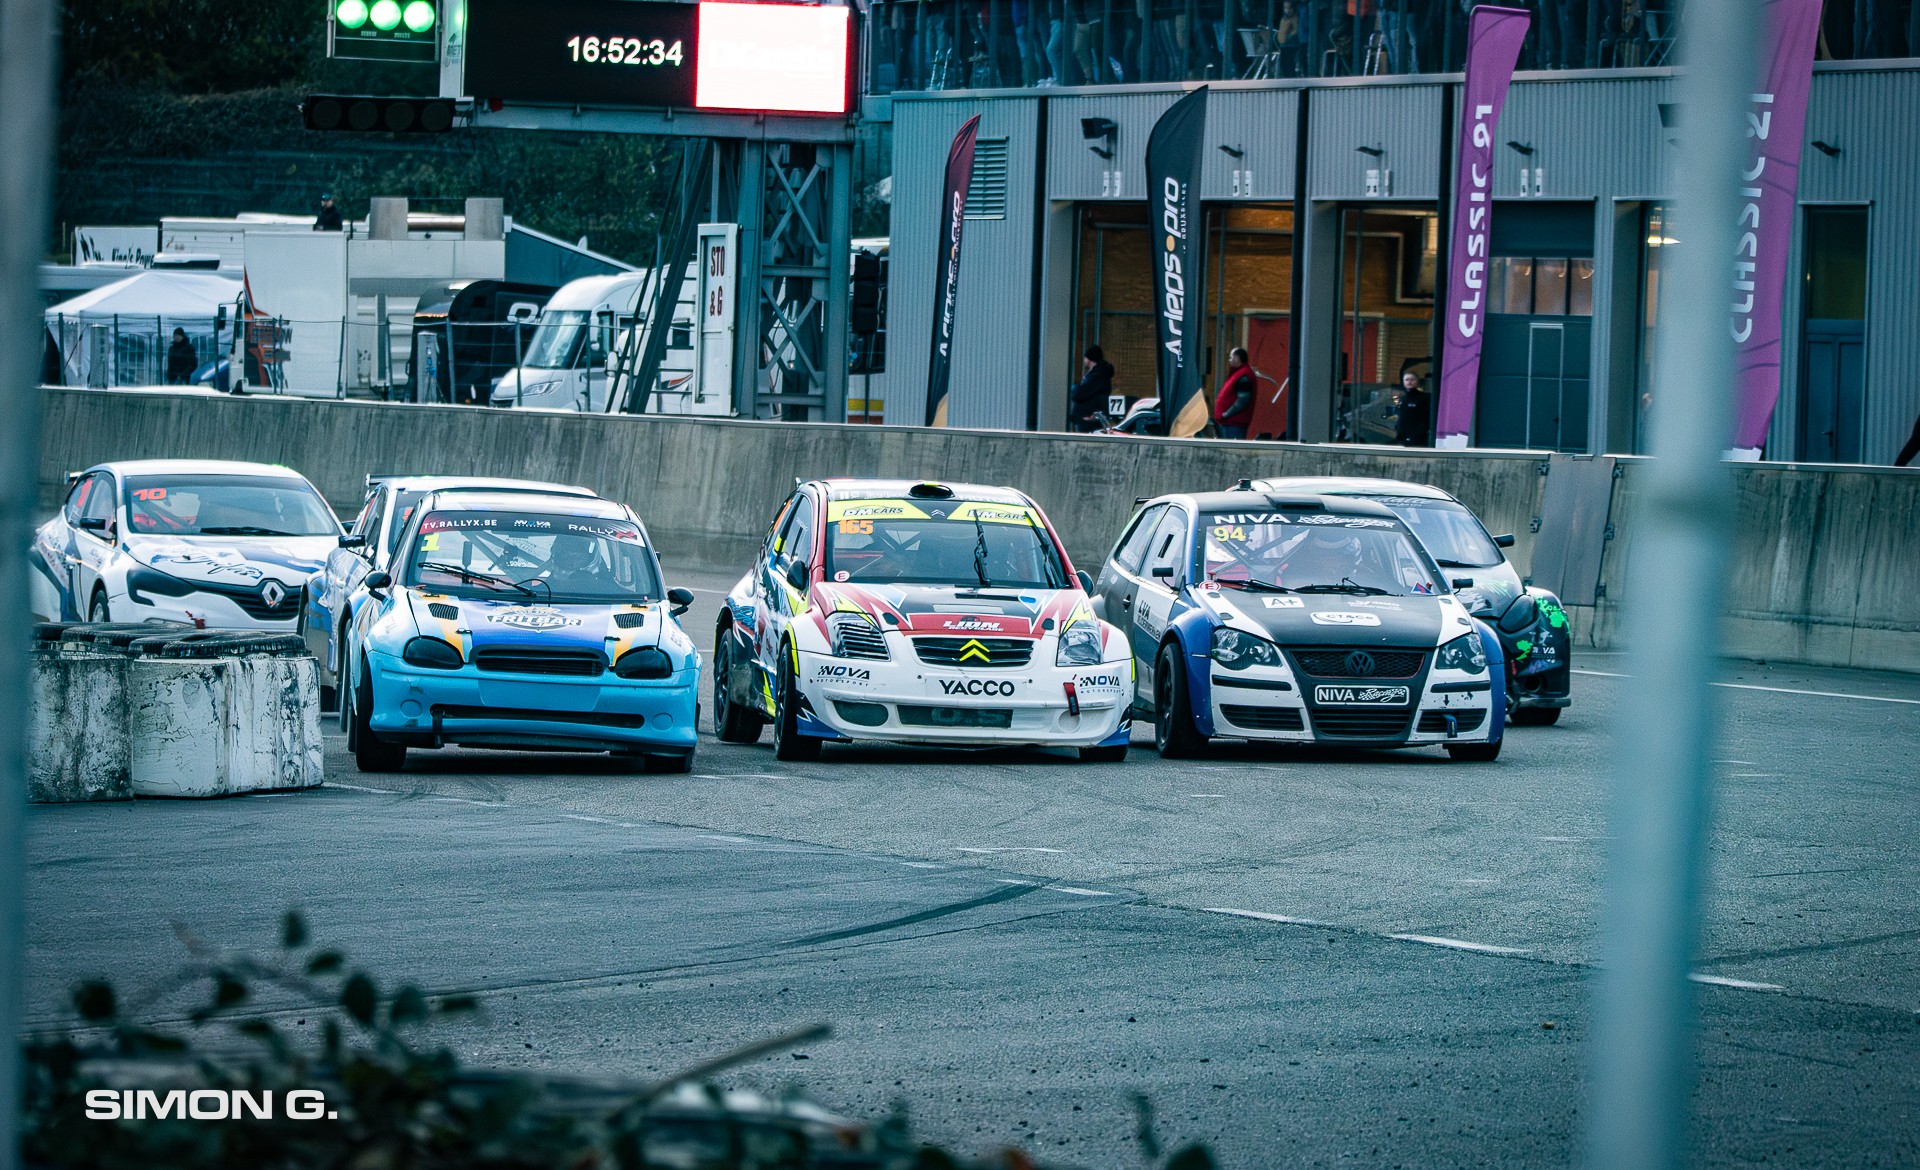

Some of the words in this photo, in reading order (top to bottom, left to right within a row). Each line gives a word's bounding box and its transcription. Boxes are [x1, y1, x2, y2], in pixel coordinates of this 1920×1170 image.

[567, 36, 684, 66] 16:52:34
[1458, 163, 1487, 338] CLASSIC
[711, 246, 725, 277] STO
[717, 286, 723, 316] G
[1110, 399, 1123, 411] 77
[133, 488, 167, 500] 10
[1213, 513, 1291, 524] NIVA
[837, 520, 874, 534] 165
[1213, 527, 1246, 541] 94
[420, 534, 440, 551] 1
[1271, 598, 1298, 606] A+
[943, 620, 1001, 630] LION
[817, 665, 871, 680] NOVA
[939, 679, 1015, 696] YACCO
[1079, 675, 1121, 687] NOVA
[1318, 688, 1355, 701] NIVA
[1358, 688, 1406, 703] Racing
